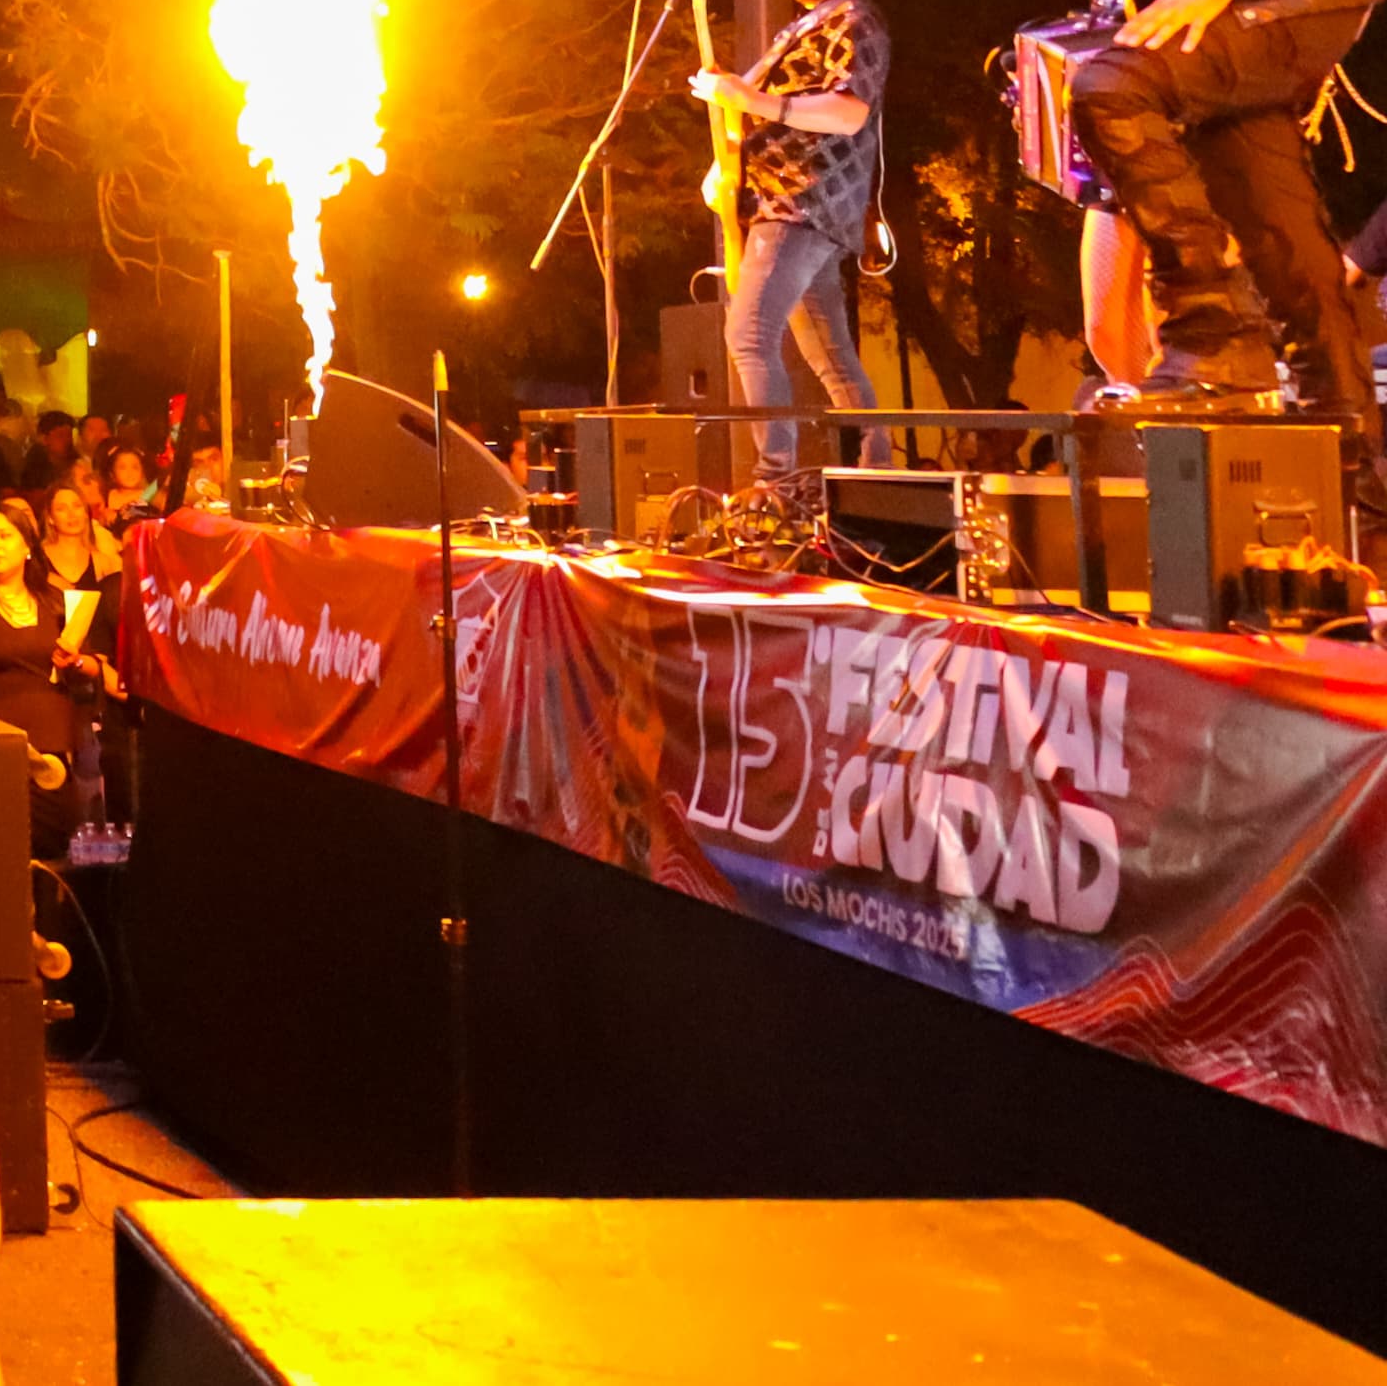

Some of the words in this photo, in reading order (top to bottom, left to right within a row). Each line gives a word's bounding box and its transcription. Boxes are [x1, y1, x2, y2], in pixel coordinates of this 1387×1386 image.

[827, 627, 1130, 798] FESTIVAL
[782, 873, 823, 914] LOS
[825, 885, 907, 942] MOCHIS
[831, 756, 1121, 934] CIUDAD
